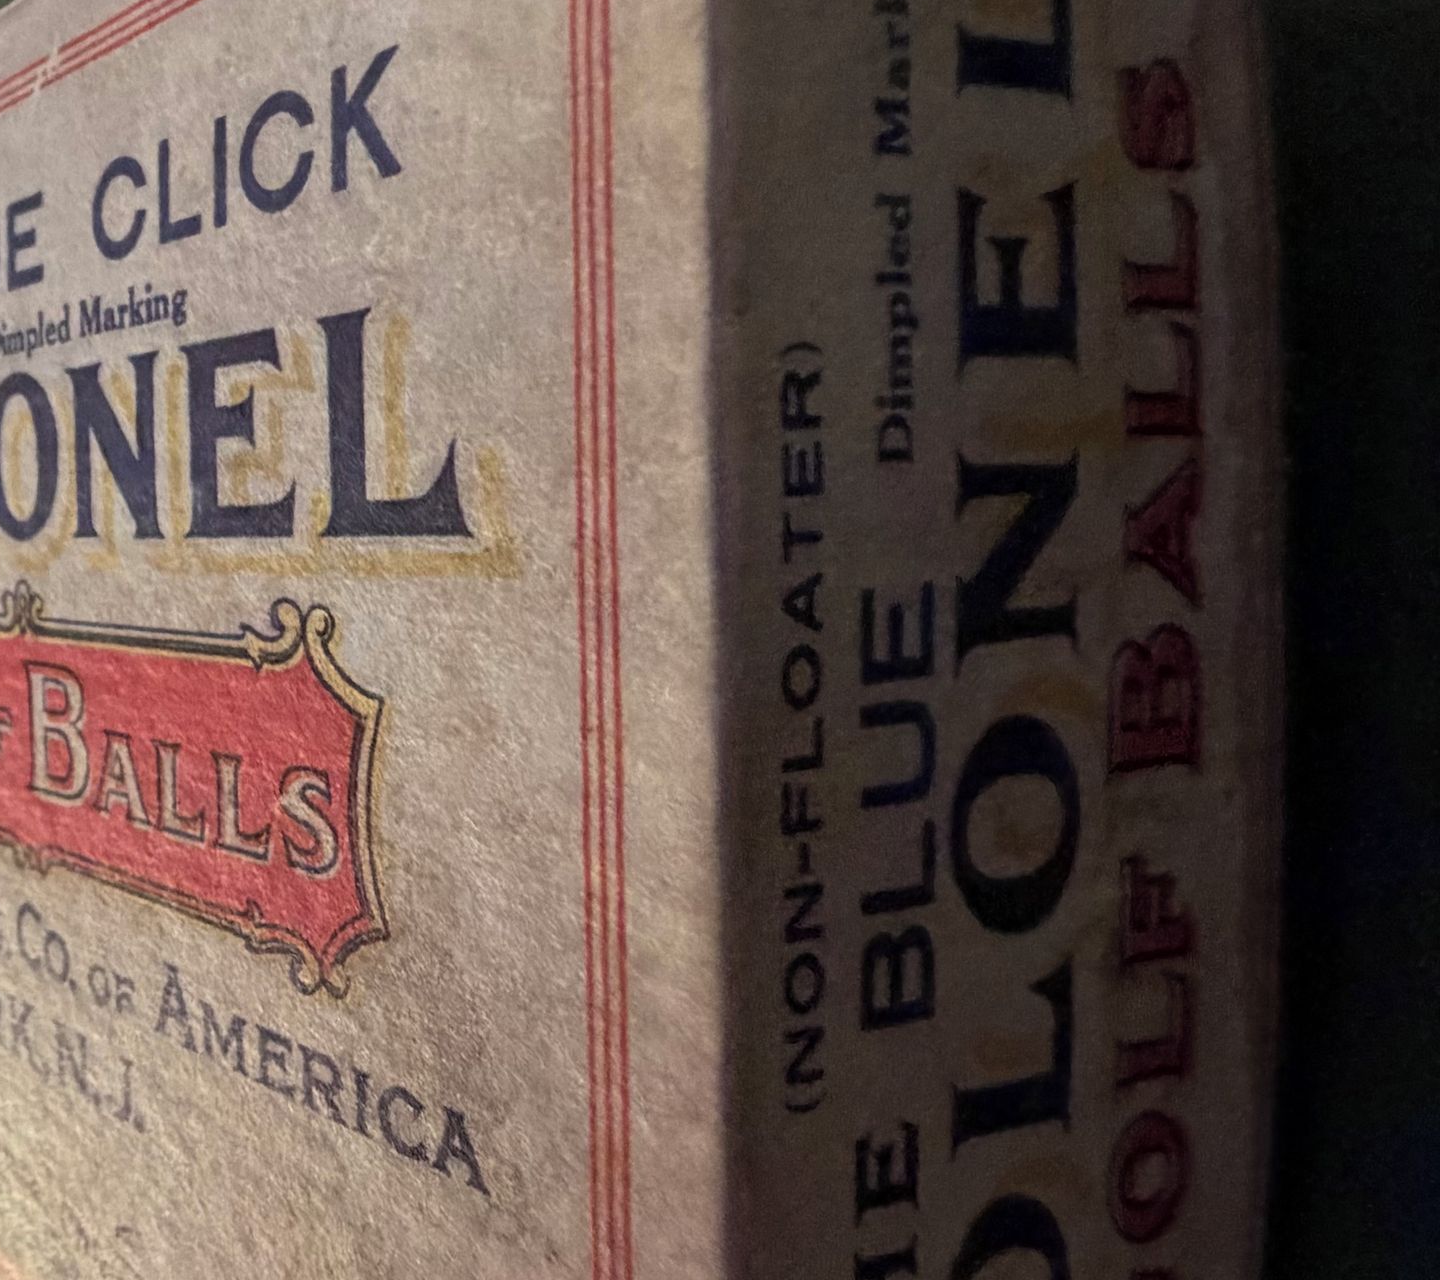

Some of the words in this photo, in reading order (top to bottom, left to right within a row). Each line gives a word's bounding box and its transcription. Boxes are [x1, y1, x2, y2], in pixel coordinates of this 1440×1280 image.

[91, 44, 404, 261] CLICK
[79, 284, 189, 337] Marking
[873, 190, 918, 465] Dimpled
[1106, 57, 1205, 775] BALLS
[22, 660, 344, 880] BALLS
[779, 338, 825, 1115] (NON-FLOATER)
[858, 578, 936, 1033] BLUE
[16, 901, 77, 993] CO.
[87, 963, 136, 1014] OF
[152, 962, 492, 1197] AMERICA
